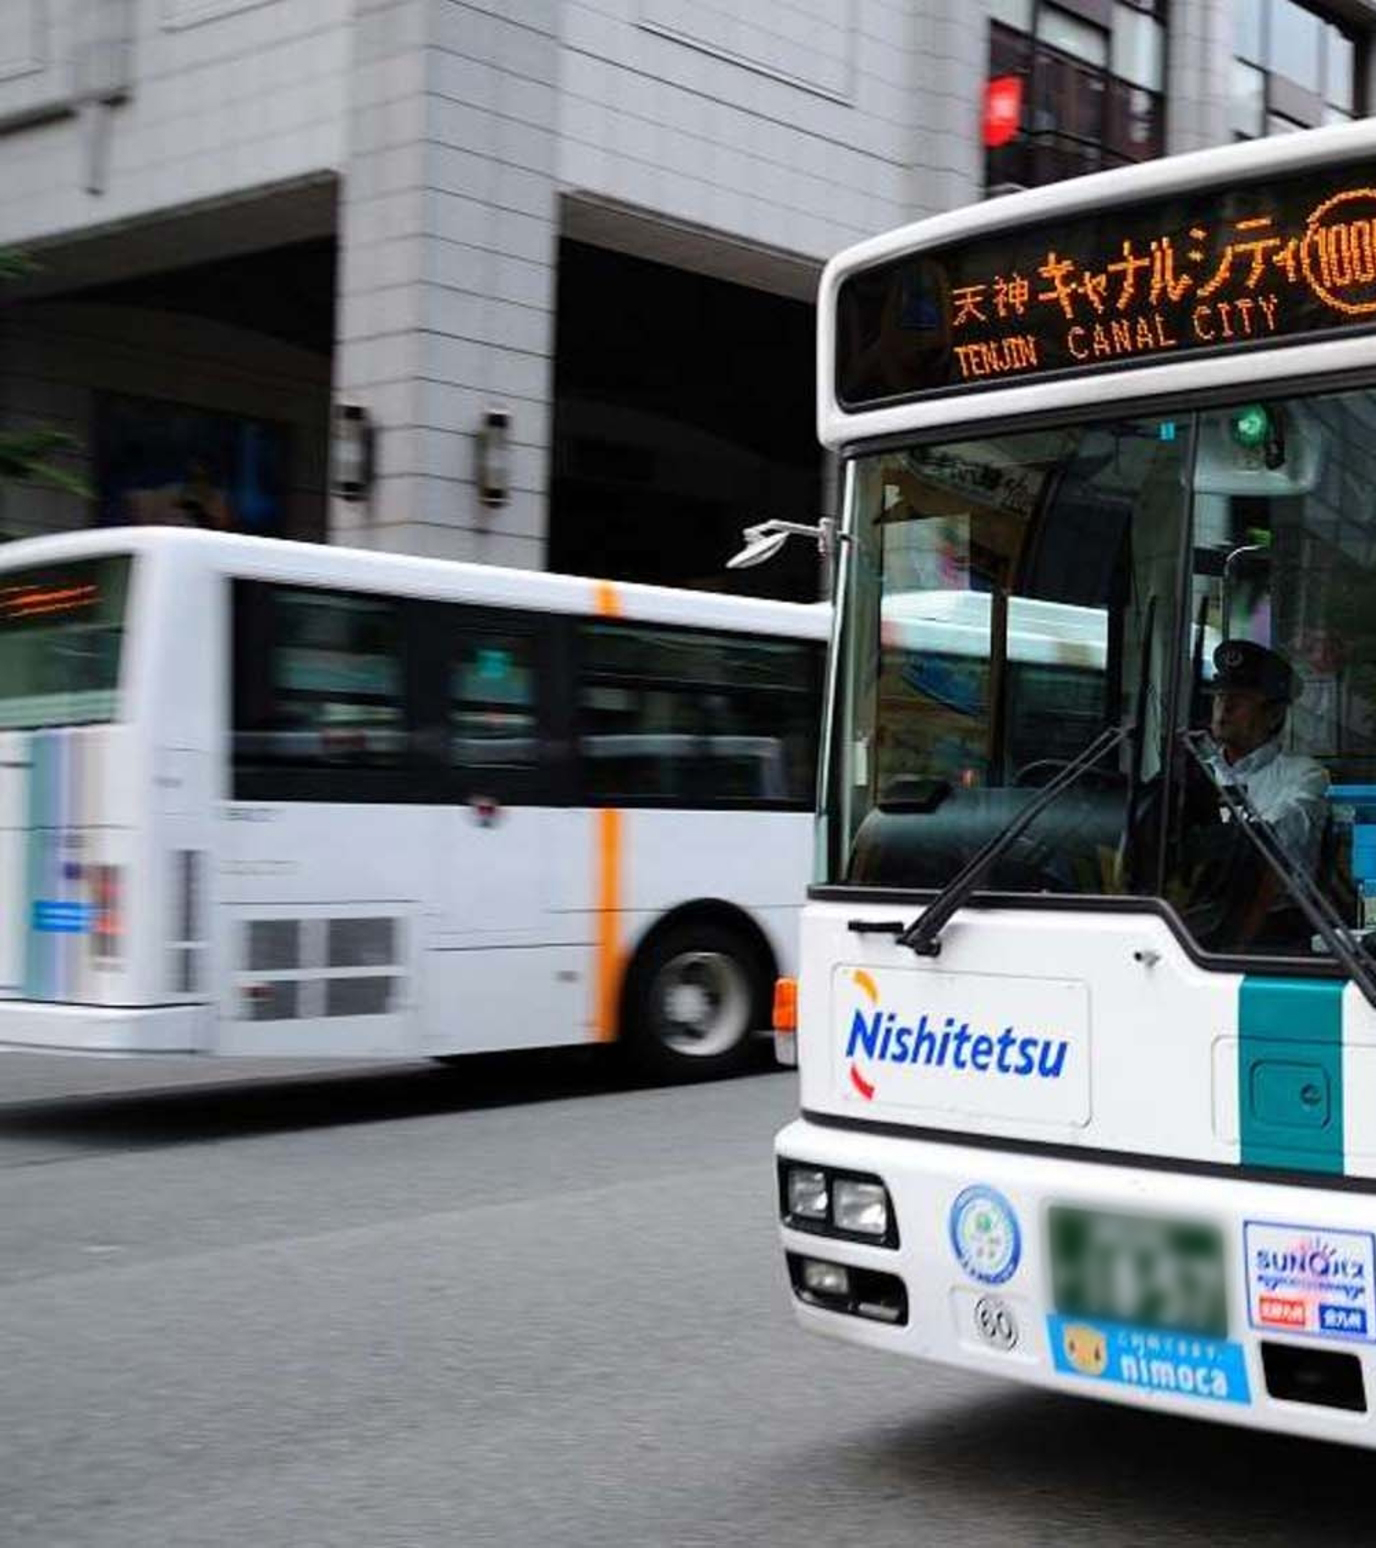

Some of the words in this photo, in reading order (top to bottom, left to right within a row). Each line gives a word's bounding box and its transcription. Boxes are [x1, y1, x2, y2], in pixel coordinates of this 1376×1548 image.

[953, 272, 1028, 325] 天神
[1037, 216, 1299, 319] キャナルシティ
[952, 335, 1038, 377] TENJIN
[1067, 313, 1178, 360] CANAL
[1192, 294, 1278, 340] CITY
[846, 1007, 1069, 1078] Nishitetsu
[1119, 1353, 1228, 1398] nimoca
